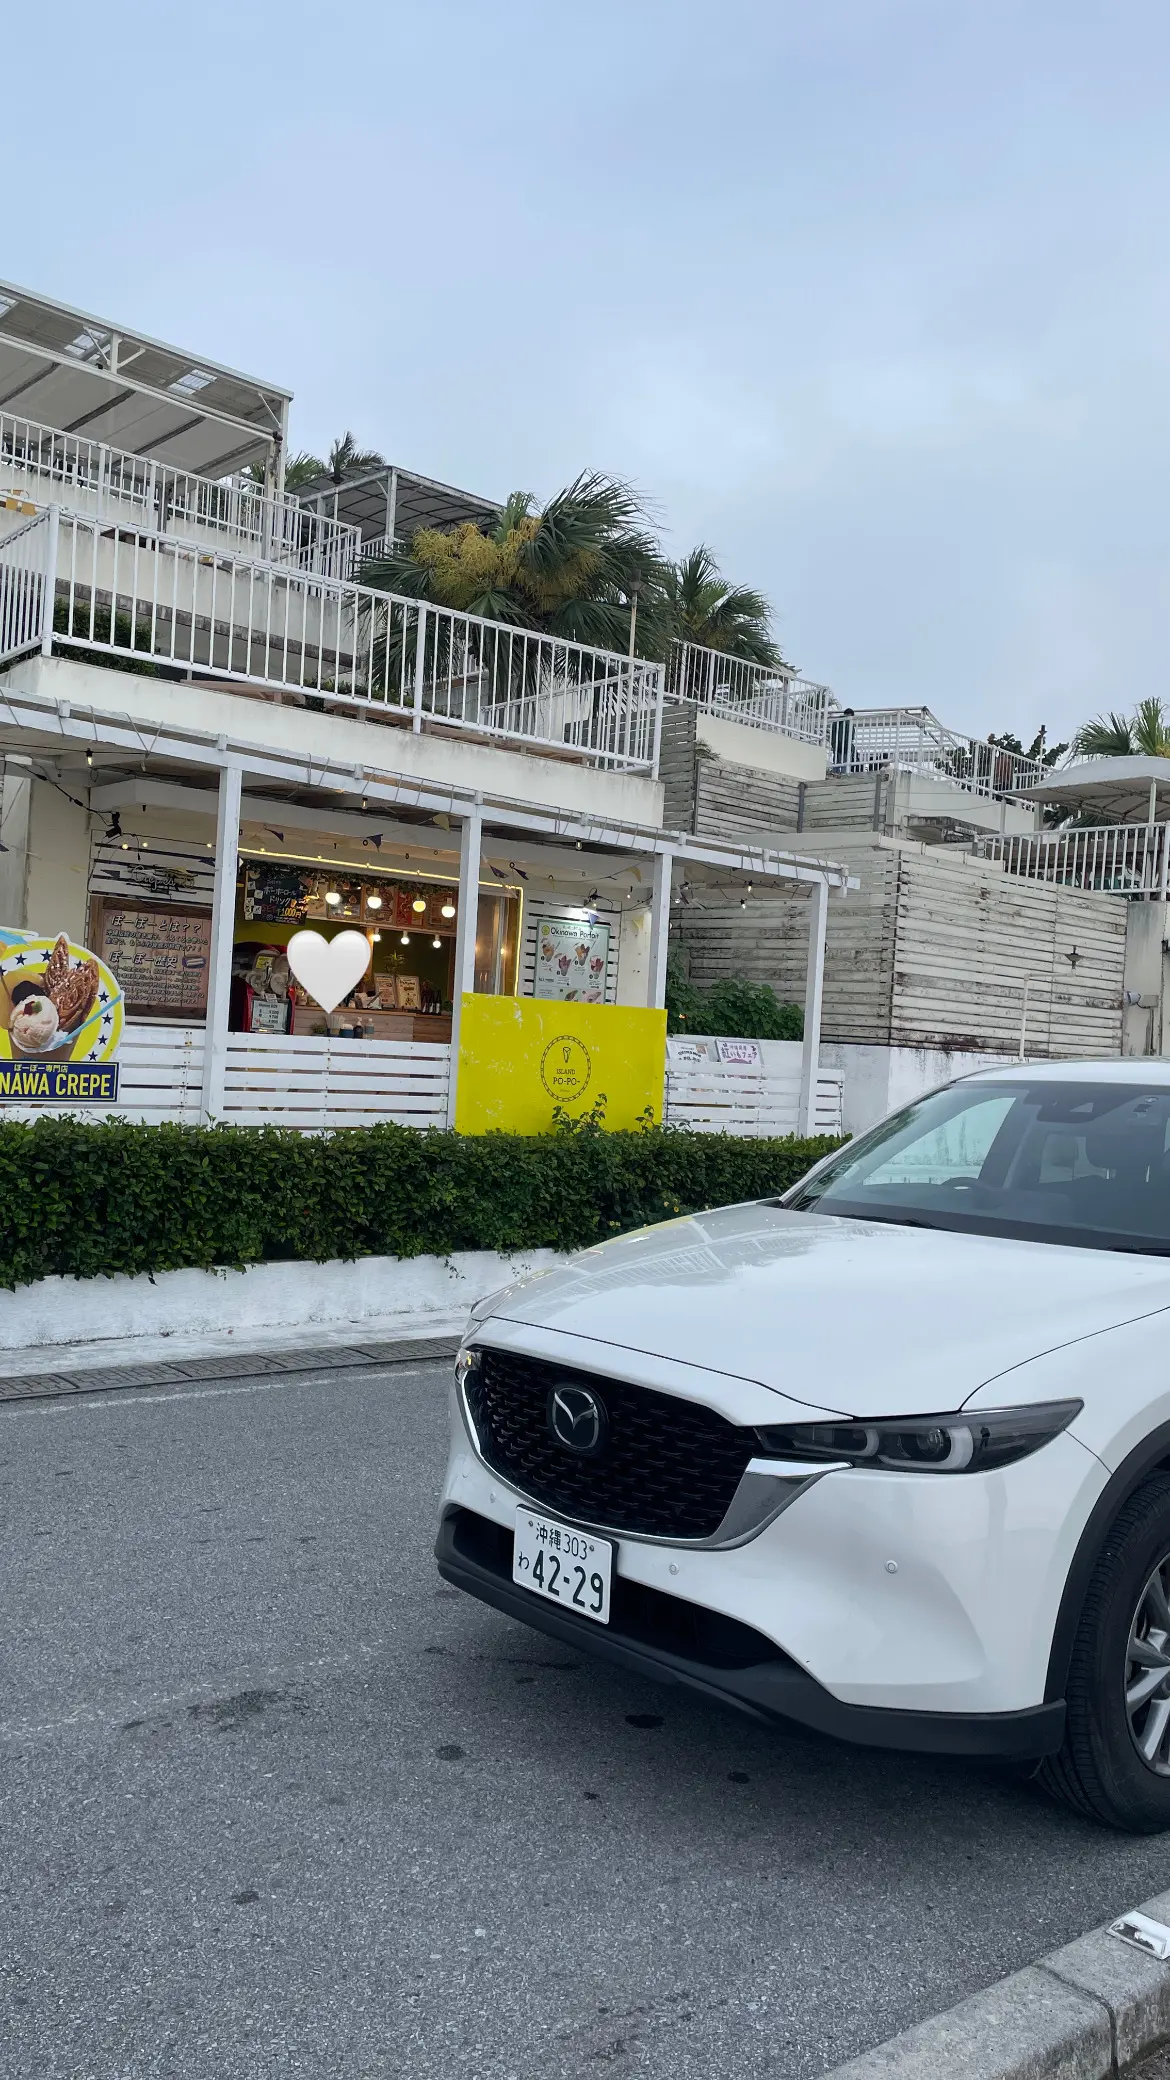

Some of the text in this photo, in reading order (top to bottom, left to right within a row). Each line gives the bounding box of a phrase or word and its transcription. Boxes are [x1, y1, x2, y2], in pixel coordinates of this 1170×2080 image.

[550, 927, 578, 937] Okinawa
[579, 930, 600, 939] Parfait
[13, 1063, 69, 1073] ぽーぽー専門店
[55, 1073, 111, 1096] CREPE
[518, 1549, 604, 1614] わ 42-29
